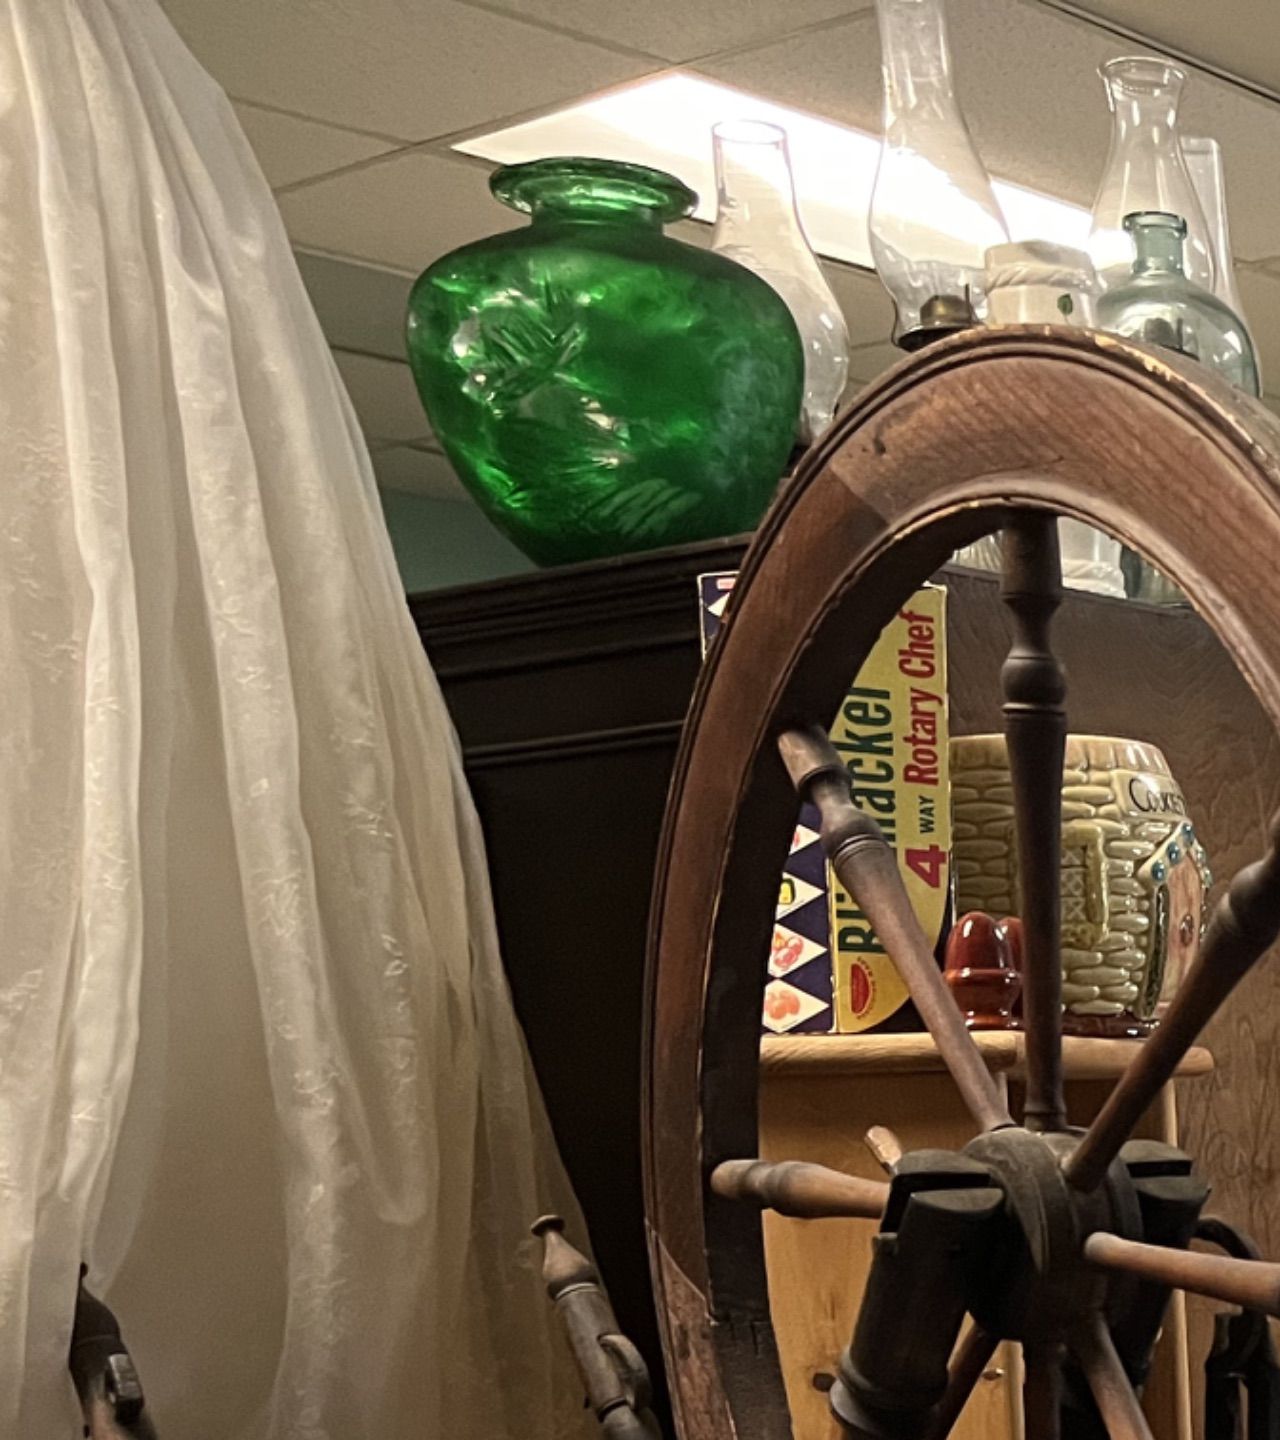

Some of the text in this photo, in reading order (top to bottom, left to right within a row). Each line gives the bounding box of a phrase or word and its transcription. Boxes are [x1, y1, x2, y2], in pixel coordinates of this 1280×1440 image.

[898, 610, 946, 888] 4 WAY Rotary Chef
